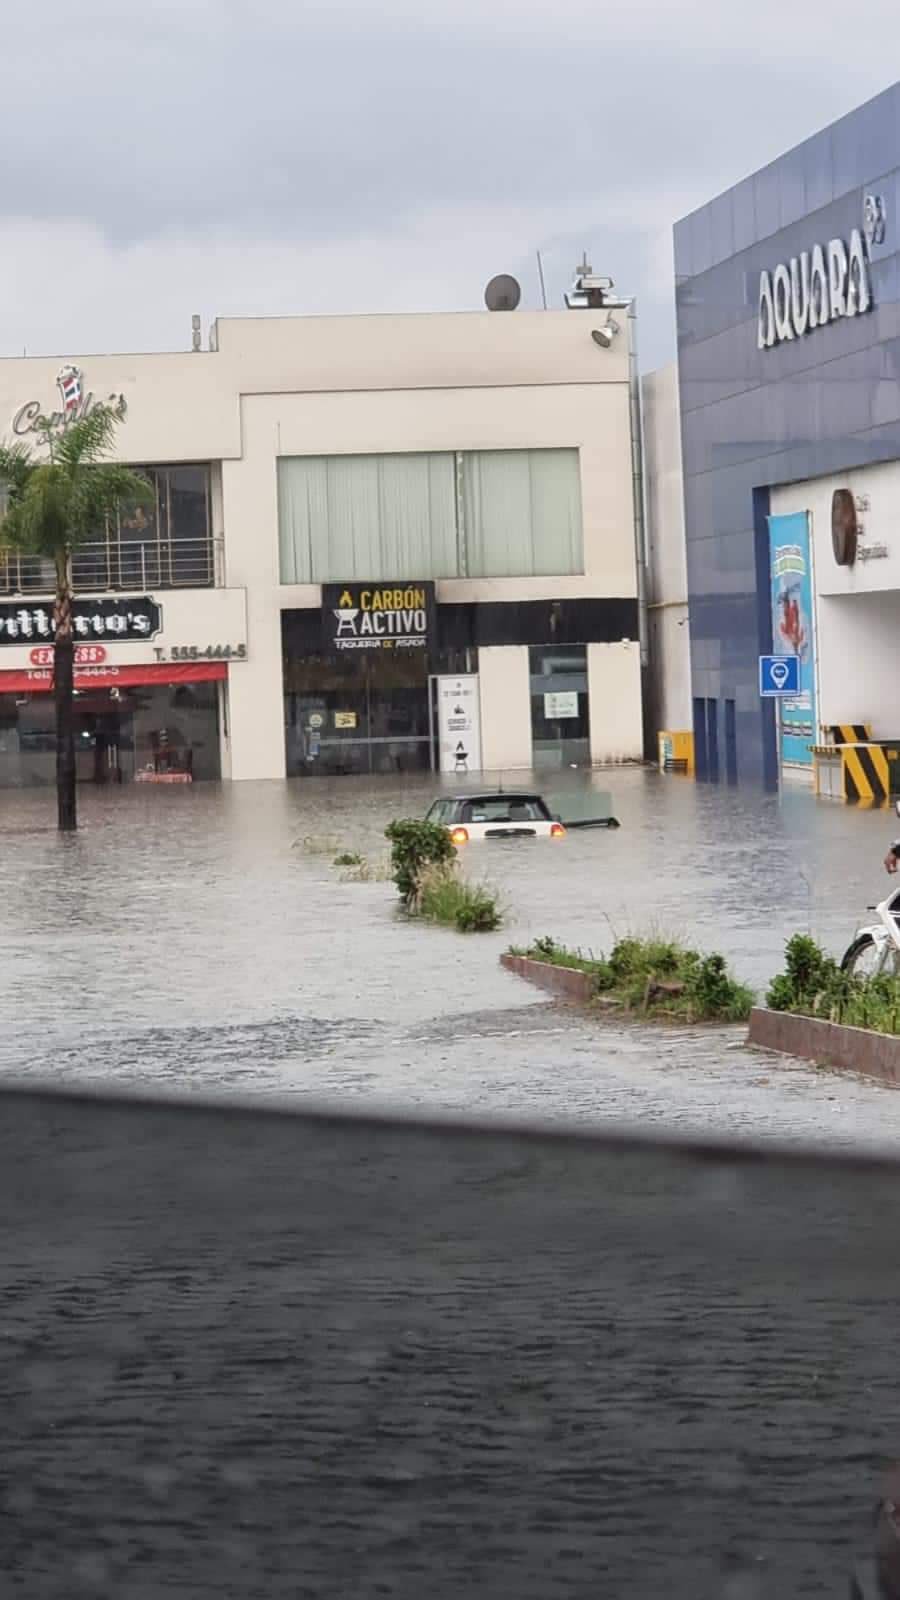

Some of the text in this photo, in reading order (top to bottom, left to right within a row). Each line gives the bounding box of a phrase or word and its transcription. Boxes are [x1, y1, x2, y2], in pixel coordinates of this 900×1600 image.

[757, 228, 870, 350] AQUARA
[360, 584, 426, 611] CARBÓN
[359, 609, 427, 635] ACTIVO
